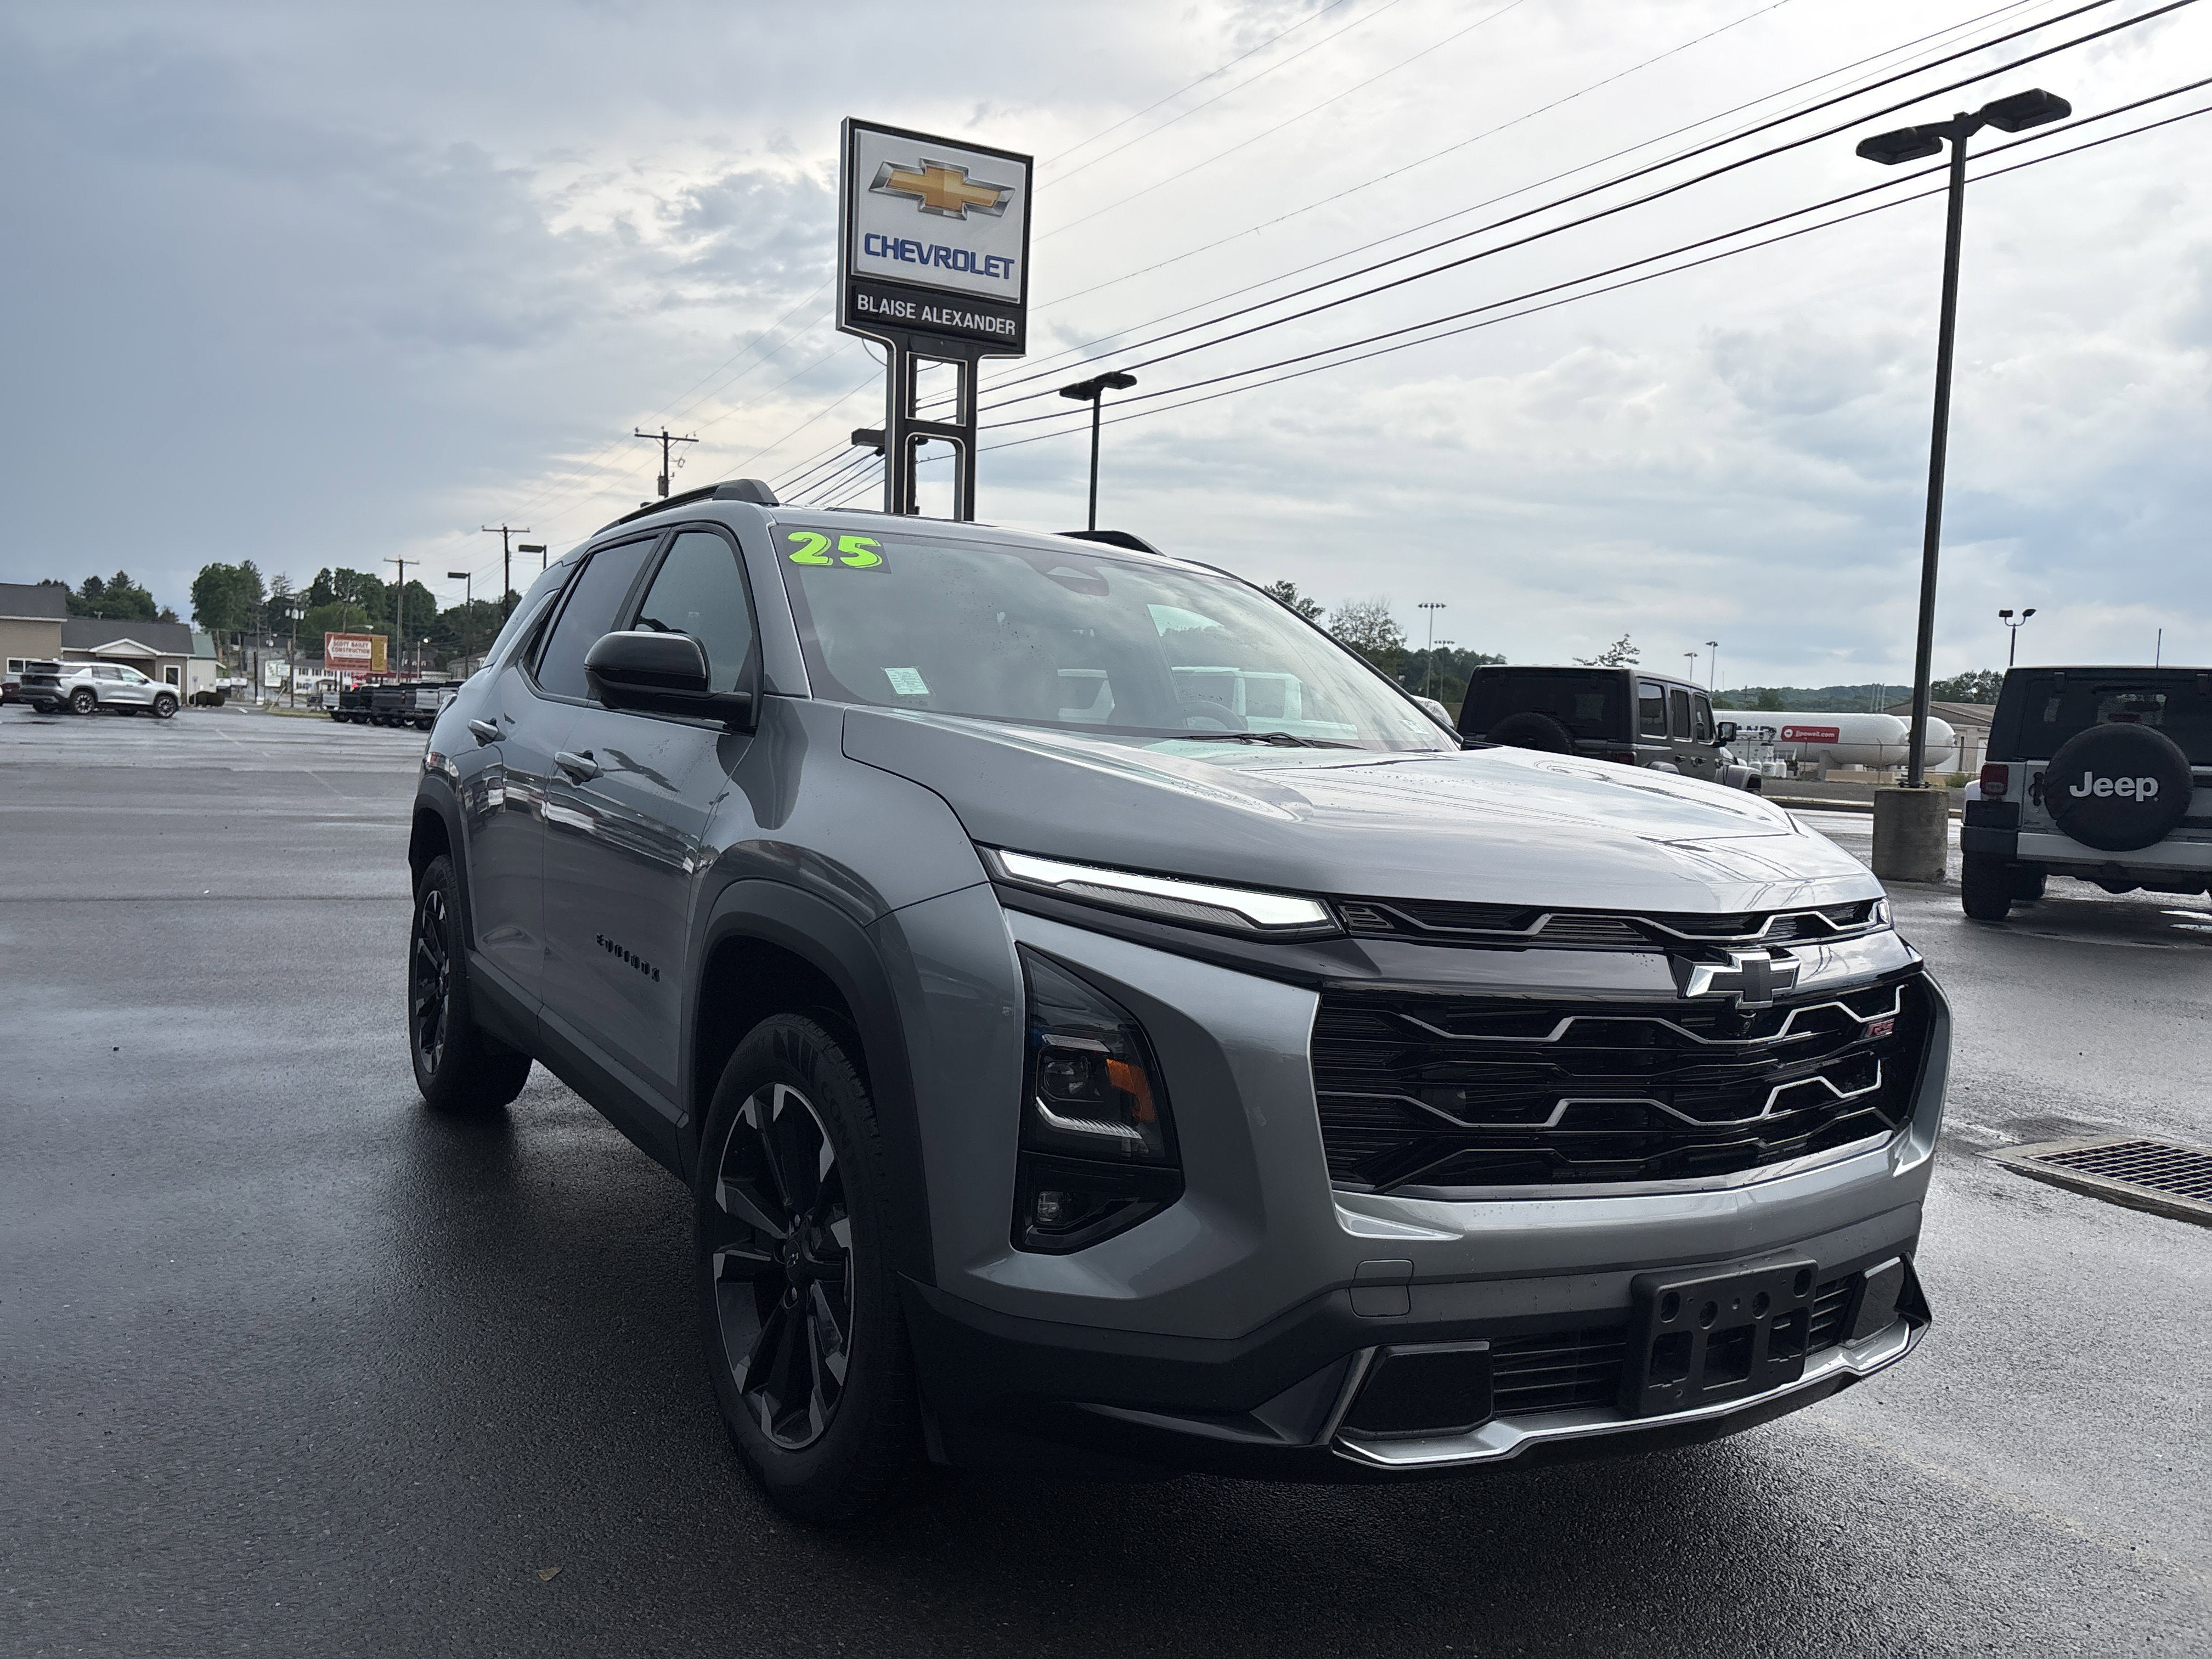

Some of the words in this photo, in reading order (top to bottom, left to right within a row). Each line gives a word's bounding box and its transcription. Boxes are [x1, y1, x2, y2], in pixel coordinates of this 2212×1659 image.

[865, 233, 1015, 279] CHEVROLET
[857, 294, 917, 319] BLAISE
[921, 305, 1016, 336] ALEXANDER
[788, 531, 883, 568] 25
[2069, 771, 2159, 802] Jeep
[1865, 1018, 1895, 1038] RS
